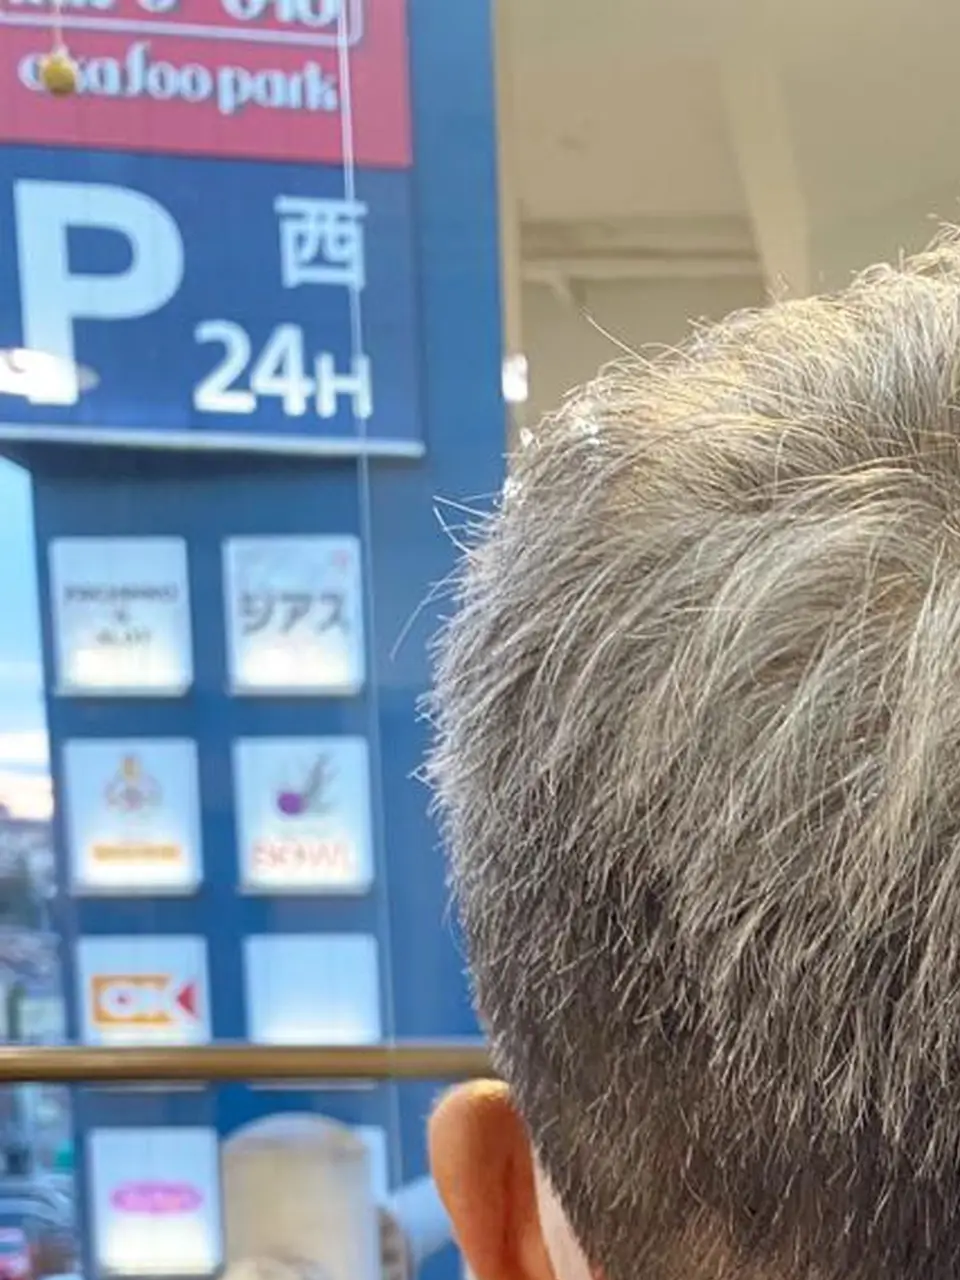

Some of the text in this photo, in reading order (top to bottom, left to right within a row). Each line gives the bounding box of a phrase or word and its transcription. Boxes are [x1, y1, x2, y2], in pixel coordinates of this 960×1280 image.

[17, 40, 338, 115] afoo park
[273, 195, 368, 289] 西
[14, 179, 184, 406] P
[194, 319, 372, 418] 24H
